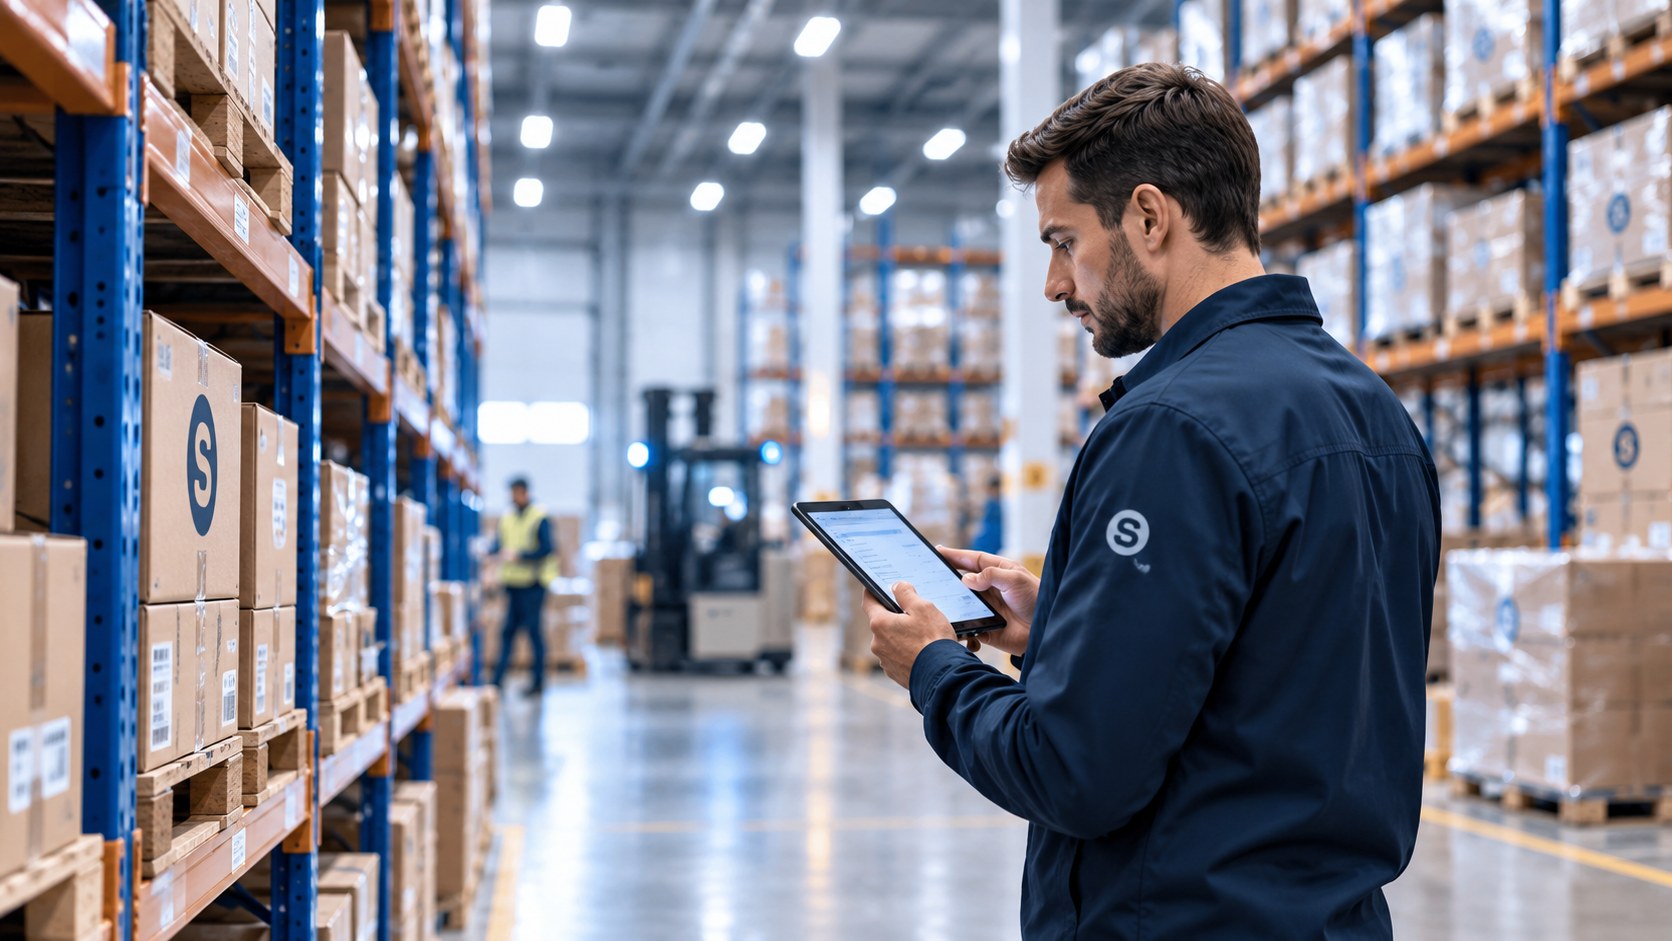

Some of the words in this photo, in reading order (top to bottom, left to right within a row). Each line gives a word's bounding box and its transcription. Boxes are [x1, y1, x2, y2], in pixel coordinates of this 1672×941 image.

[1620, 432, 1634, 462] S
[194, 421, 212, 508] S
[1113, 517, 1142, 549] S
